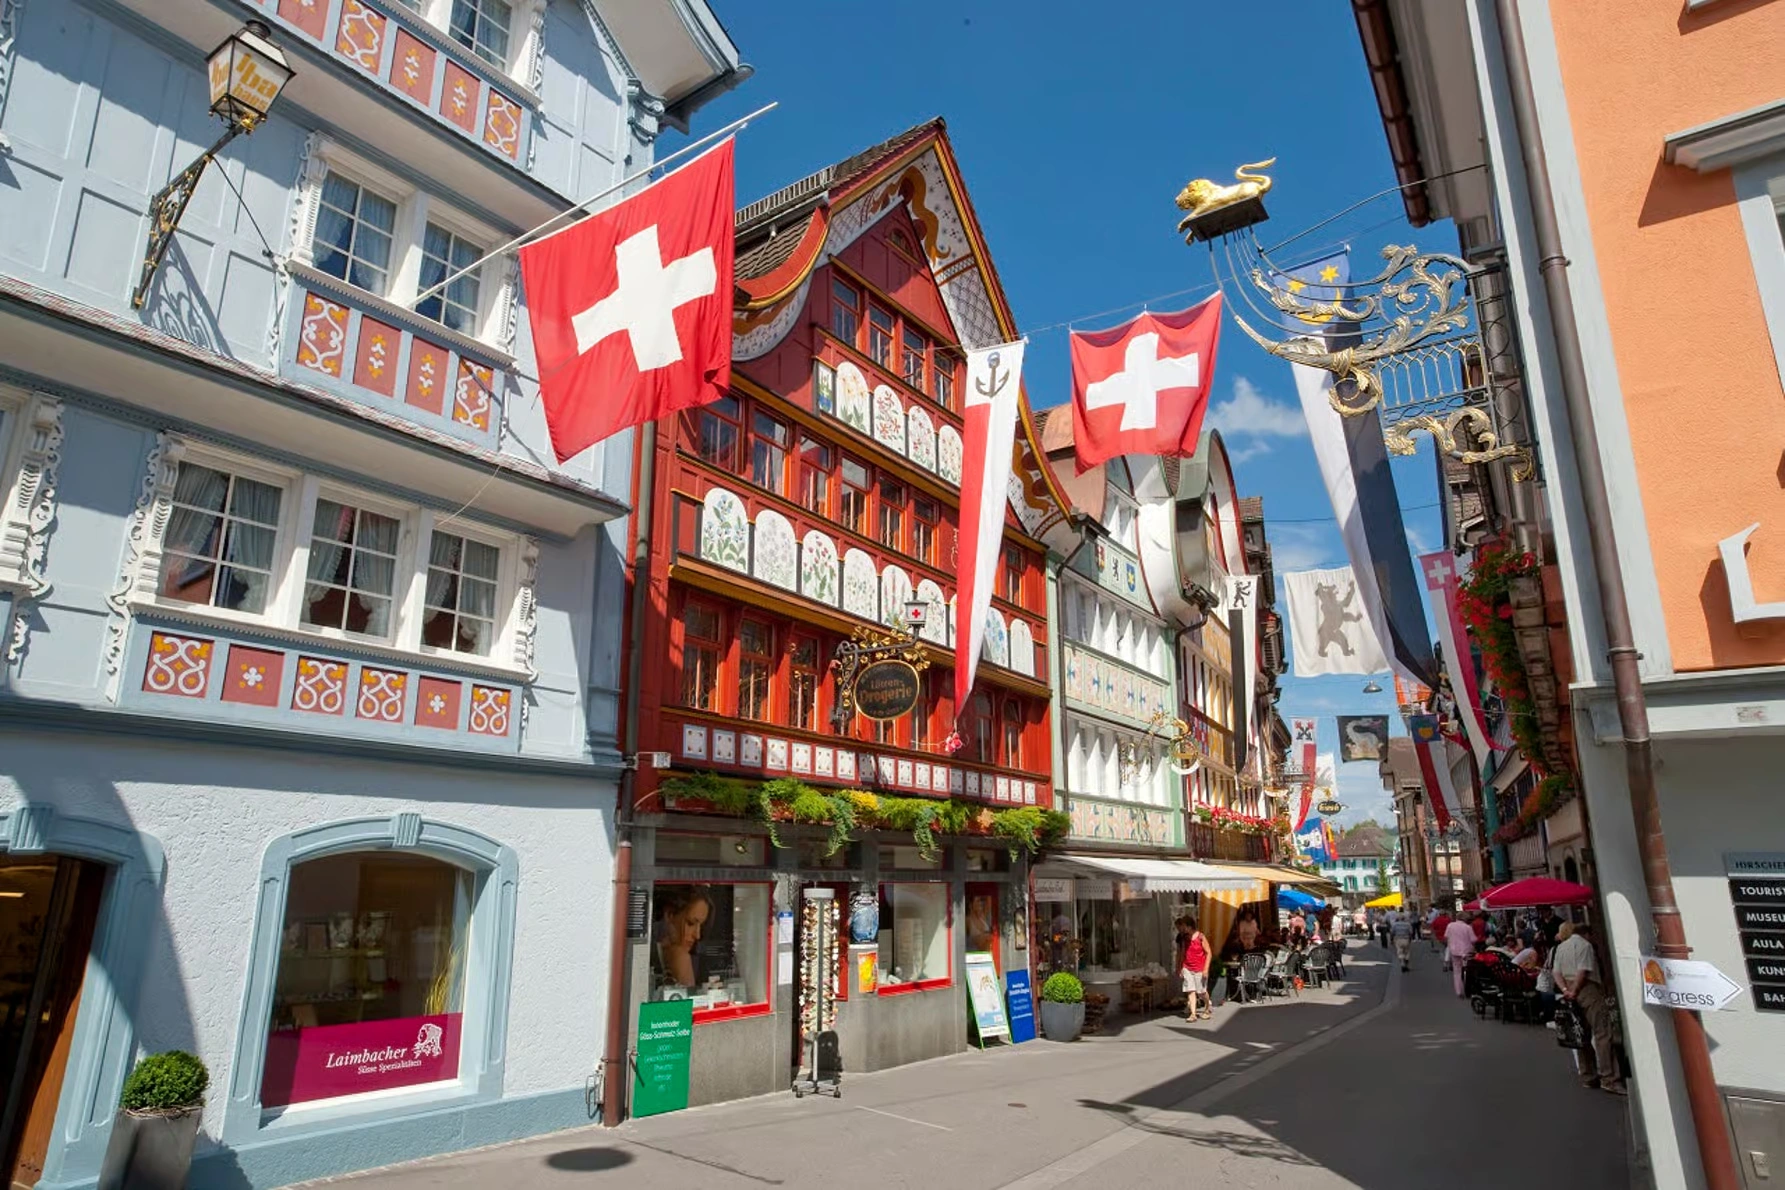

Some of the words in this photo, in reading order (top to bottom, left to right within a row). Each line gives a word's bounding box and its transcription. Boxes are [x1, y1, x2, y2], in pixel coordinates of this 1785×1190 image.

[860, 686, 912, 704] Drogerie
[1753, 939, 1784, 949] AULA
[1758, 966, 1785, 976] KUN
[1646, 985, 1715, 1006] Kogress
[325, 1046, 407, 1068] Laimbacher
